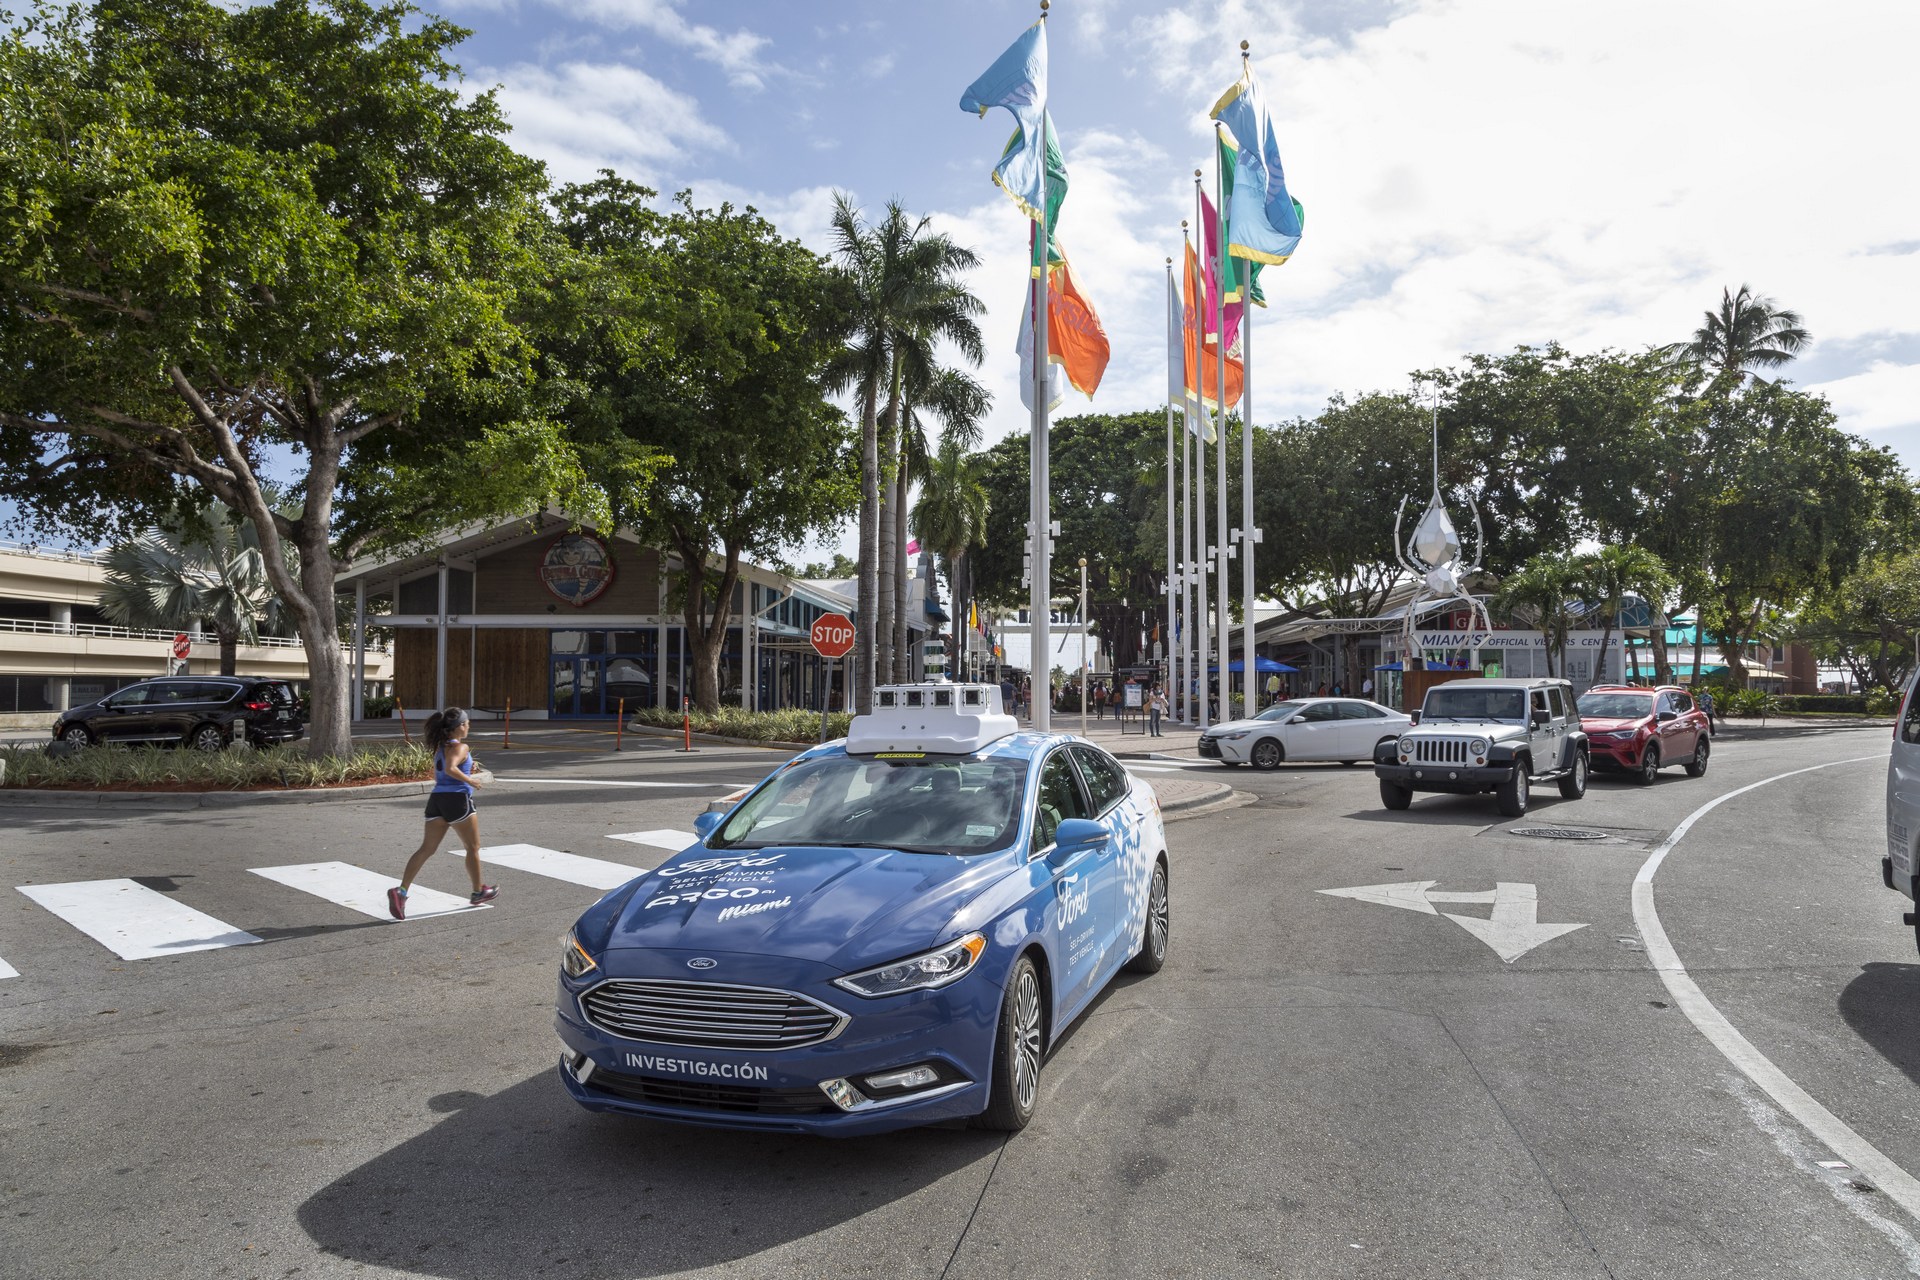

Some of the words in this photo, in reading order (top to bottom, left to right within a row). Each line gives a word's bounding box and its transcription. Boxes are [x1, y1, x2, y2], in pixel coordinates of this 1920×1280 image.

[813, 625, 853, 645] STOP
[1488, 638, 1529, 647] OFFICIAL
[658, 853, 787, 877] Ford
[669, 881, 705, 890] TEST
[709, 876, 769, 885] VEHICLE
[673, 870, 776, 885] SELF-DRIVING
[645, 887, 760, 910] ARGO
[1057, 872, 1089, 931] Ford
[625, 1053, 768, 1081] INVESTIGACIÓN
